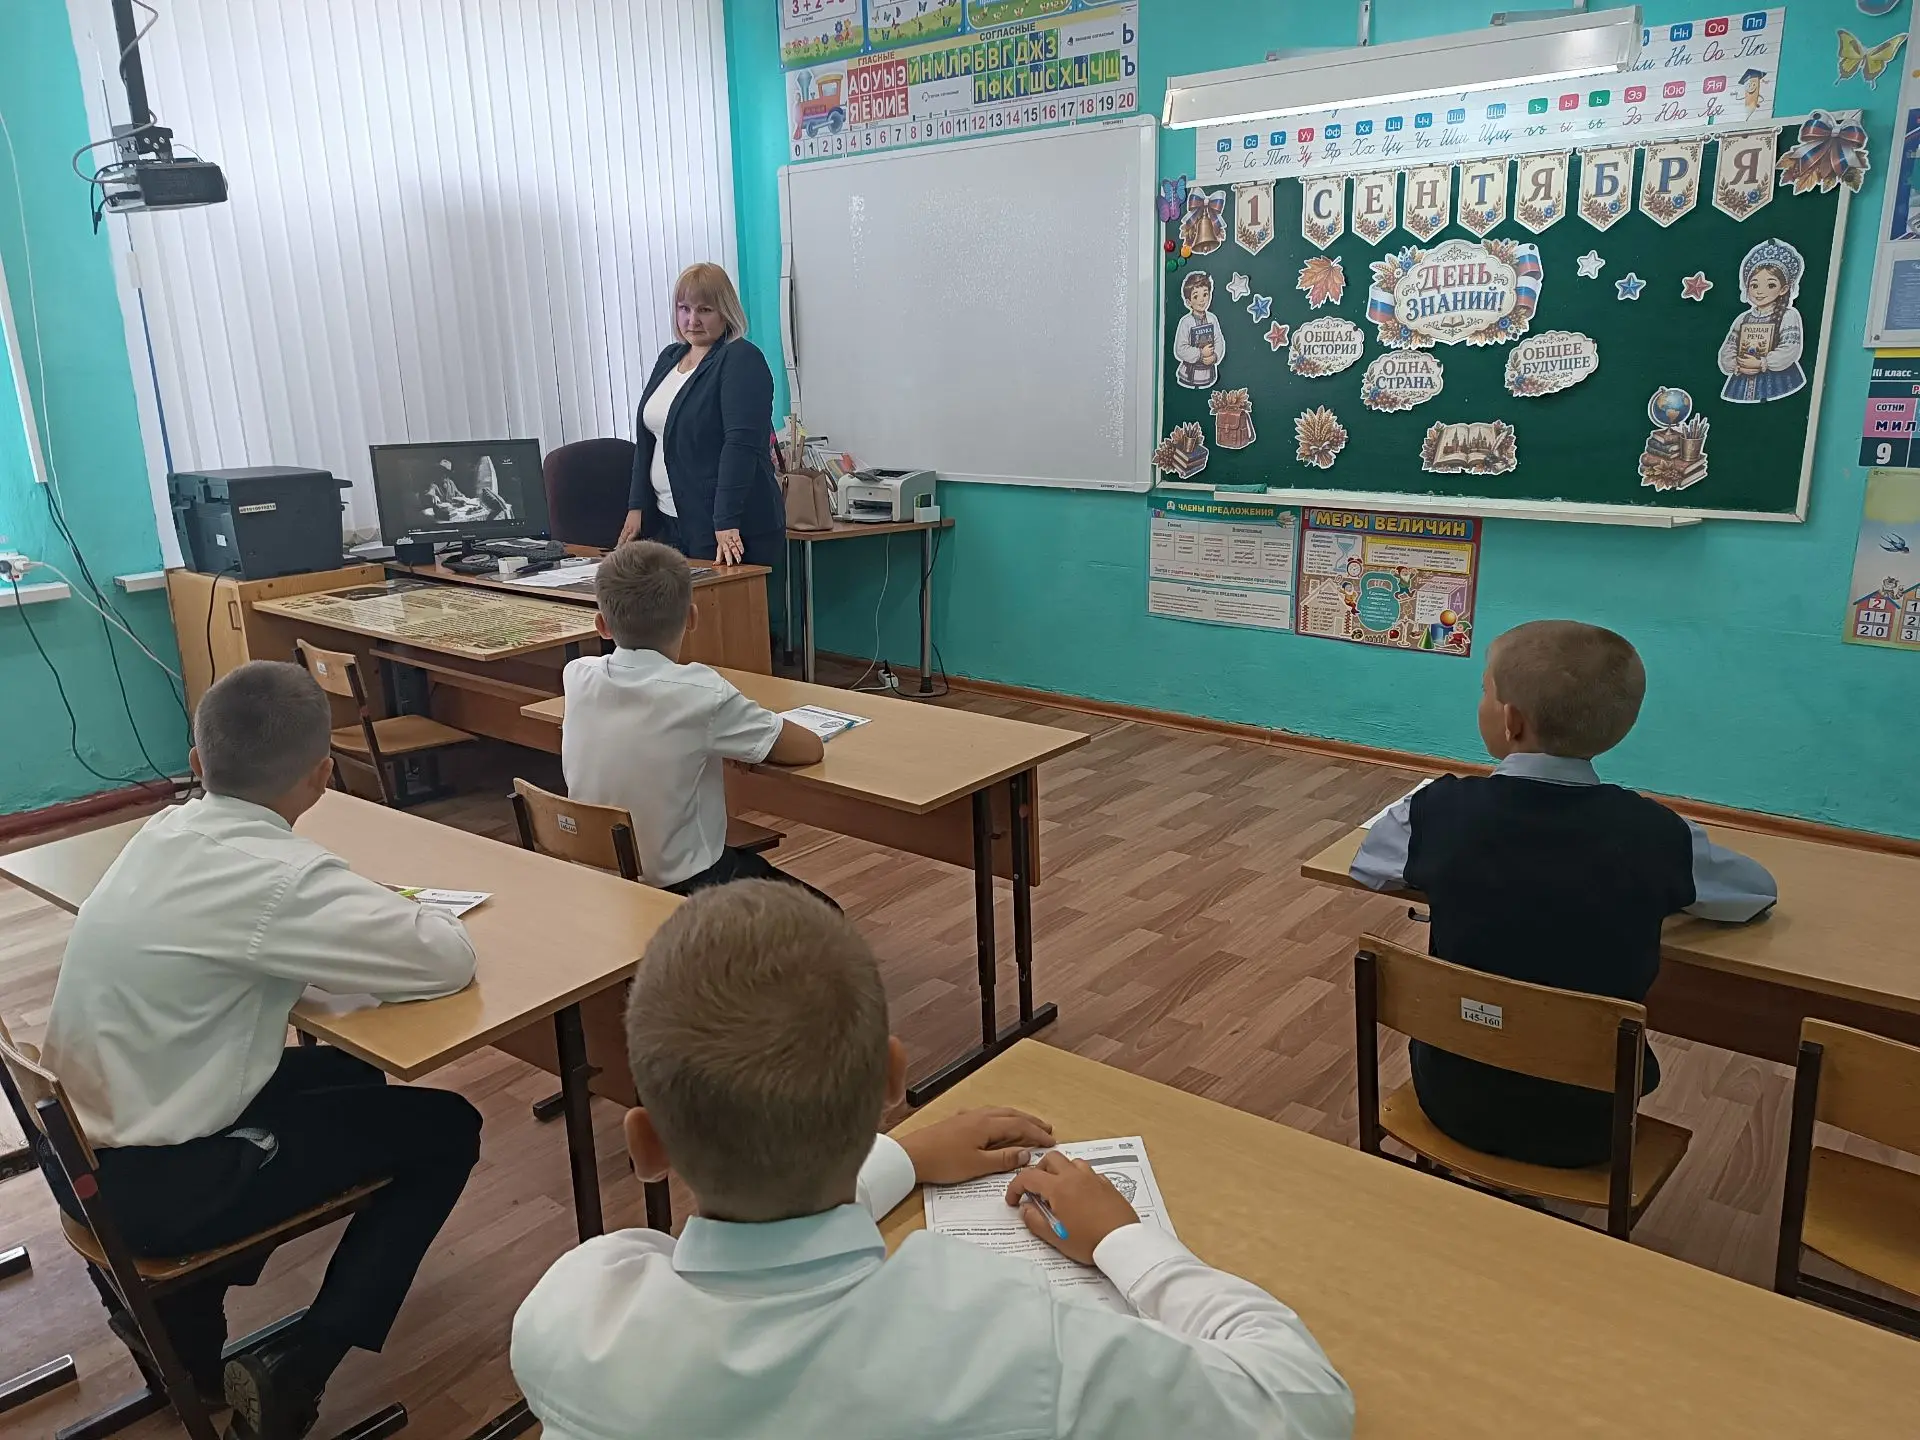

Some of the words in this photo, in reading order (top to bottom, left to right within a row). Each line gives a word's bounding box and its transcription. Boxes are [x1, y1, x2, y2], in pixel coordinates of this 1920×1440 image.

[792, 0, 800, 14] 3
[980, 22, 1036, 42] СОГЛАСНЫЕ
[1674, 28, 1690, 38] Нн
[1708, 23, 1725, 34] Оо
[1746, 17, 1762, 28] Пп
[858, 52, 895, 66] ГЛАСНЫЕ
[1665, 45, 1693, 67] Нн
[1703, 41, 1725, 62] Оо
[1734, 35, 1767, 58] Пп
[1220, 143, 1229, 151] Рр
[1274, 135, 1283, 143] Тт
[1301, 132, 1312, 141] Уу
[1326, 128, 1340, 137] Фф
[1359, 124, 1370, 133] Хх
[1388, 121, 1401, 132] Цц
[1418, 117, 1430, 126] Чч
[1565, 99, 1573, 107] ы
[1627, 90, 1643, 100] Ээ
[1664, 85, 1685, 95] Юю
[1706, 80, 1723, 90] Яя
[795, 144, 800, 156] 0
[809, 142, 813, 154] 1
[823, 140, 828, 152] 2
[837, 138, 842, 150] 3
[850, 136, 856, 148] 4
[866, 134, 871, 146] 5
[880, 131, 886, 143] 6
[896, 129, 901, 141] 7
[910, 127, 916, 139] 8
[926, 124, 932, 137] 9
[940, 121, 951, 135] 10
[956, 118, 967, 132] 11
[972, 115, 985, 130] 12
[988, 113, 1002, 128] 13
[1006, 110, 1020, 125] 14
[1024, 108, 1037, 122] 15
[1042, 105, 1056, 119] 16
[1060, 102, 1075, 116] 17
[1079, 99, 1094, 114] 18
[1099, 95, 1114, 111] 19
[1118, 92, 1134, 108] 20
[1216, 155, 1232, 177] Рр
[1243, 152, 1257, 169] Сс
[1263, 148, 1292, 166] Тт
[1297, 145, 1312, 168] Уу
[1321, 142, 1341, 164] Фф
[1350, 138, 1375, 156] Хх
[1382, 135, 1404, 156] Цц
[1415, 132, 1431, 148] Чч
[1440, 128, 1470, 147] Шш
[1479, 124, 1512, 145] Щщ
[1622, 106, 1642, 126] Ээ
[1655, 101, 1688, 122] Юю
[1698, 97, 1725, 117] Яя
[1247, 194, 1261, 227] 1
[1417, 263, 1492, 297] ДЕНЬ
[1406, 286, 1505, 322] ЗНАНИЙ!
[1303, 343, 1357, 355] ИСТОРИЯ
[1522, 343, 1583, 360] ОБЩЕЕ
[1522, 356, 1591, 375] БУДУЩЕЕ
[1376, 376, 1435, 390] СТРАНА
[1875, 421, 1920, 431] МИЛ
[1876, 442, 1892, 464] 9
[1178, 504, 1205, 513] ЧЛЕНЫ
[1206, 505, 1274, 516] ПРЕДЛОЖЕНИЯ
[1316, 511, 1369, 529] МЕРЫ
[1374, 516, 1466, 537] ВЕЛИЧИН
[1873, 600, 1881, 608] 2
[1912, 603, 1918, 611] 1
[1864, 612, 1870, 621] 1
[1880, 614, 1886, 622] 1
[1907, 617, 1916, 625] 2
[1860, 626, 1869, 634] 2
[1876, 627, 1884, 636] 0
[1905, 630, 1913, 639] 3
[1464, 1011, 1500, 1026] 145-160
